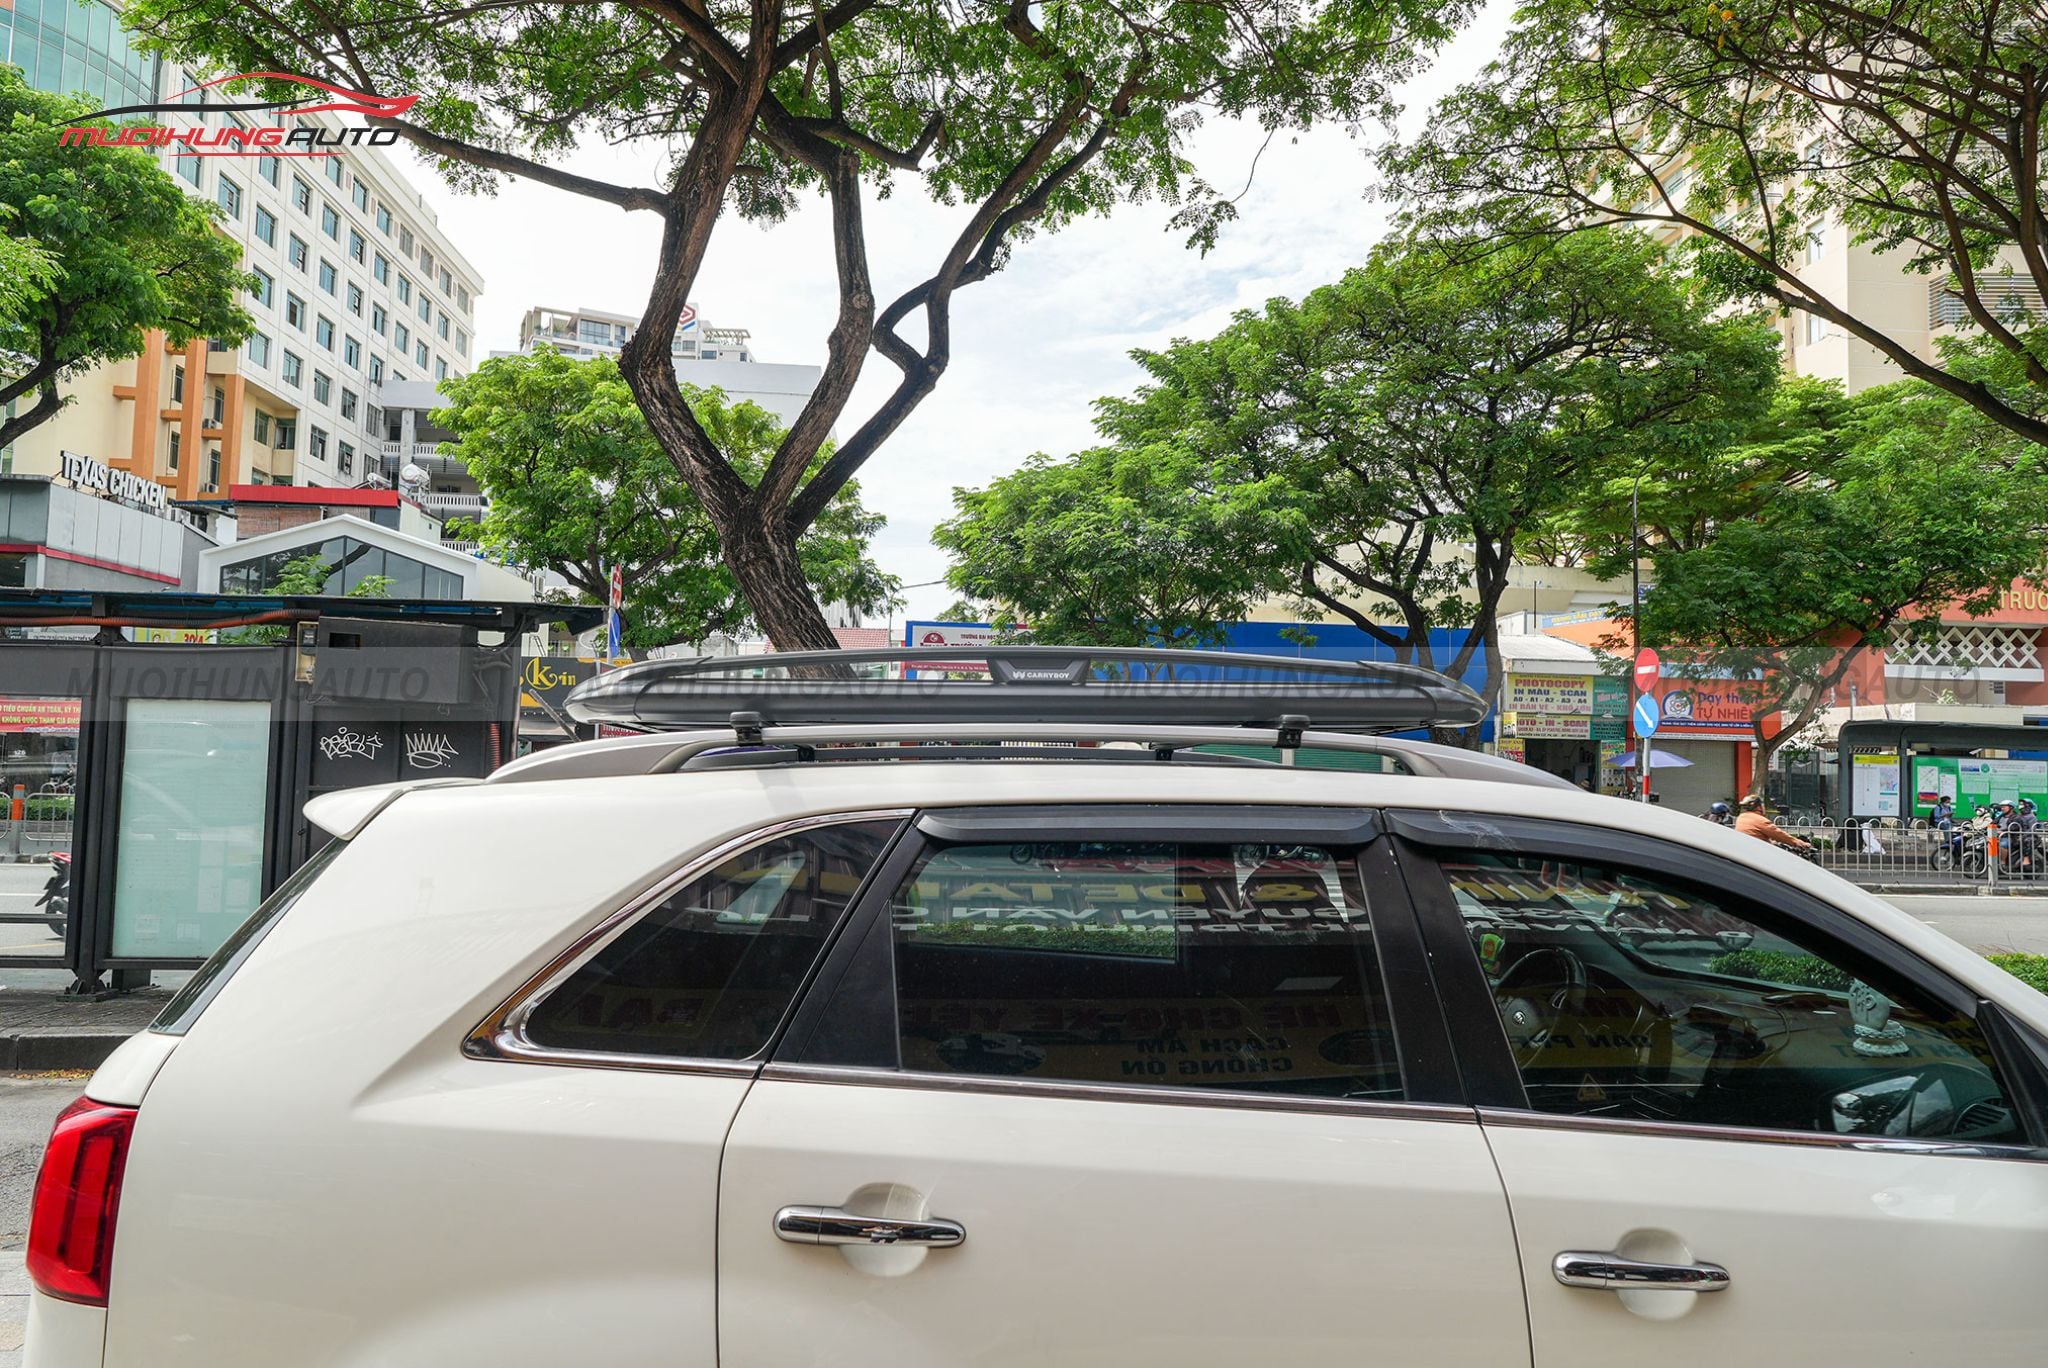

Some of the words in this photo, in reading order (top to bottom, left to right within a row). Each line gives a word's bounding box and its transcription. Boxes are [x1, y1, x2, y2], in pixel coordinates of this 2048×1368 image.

[61, 450, 109, 489] TEXAS
[108, 467, 167, 510] CHICKEN
[1026, 671, 1070, 680] CARRYBOY
[1515, 678, 1586, 689] PHOTOCOPY
[1560, 689, 1587, 697] SCAN
[1698, 691, 1722, 706] Dạy
[1696, 705, 1714, 721] TỰ
